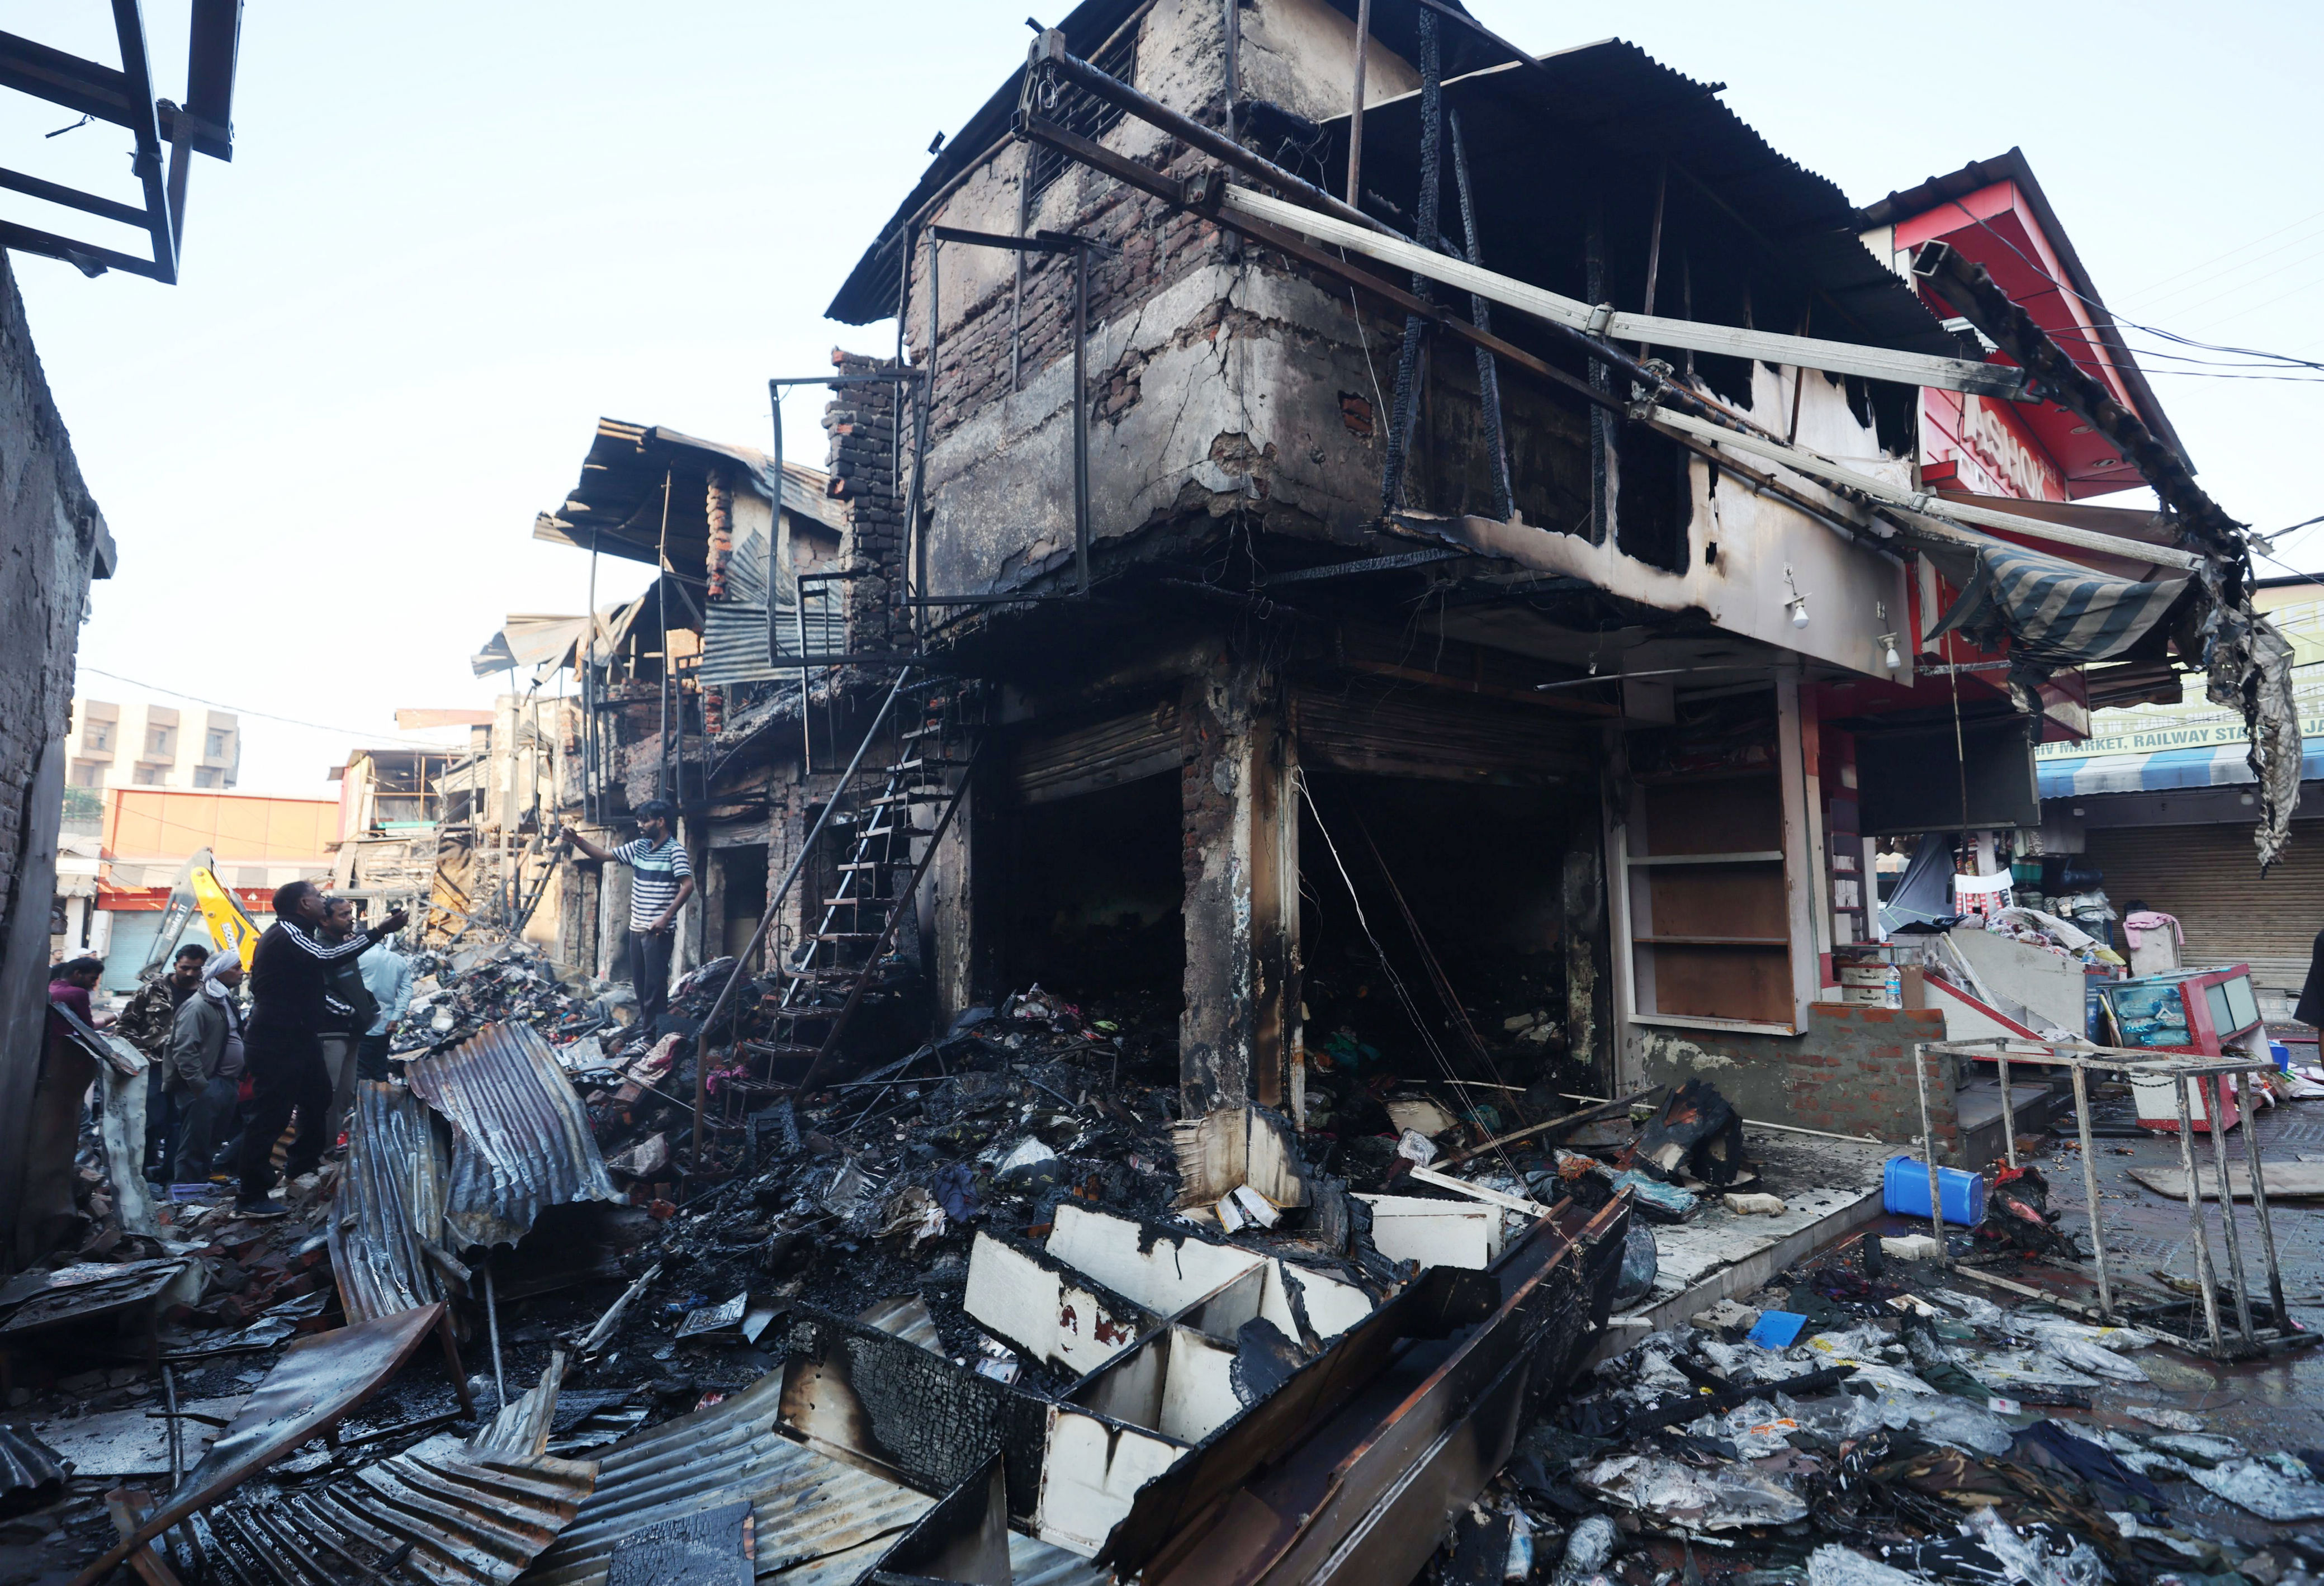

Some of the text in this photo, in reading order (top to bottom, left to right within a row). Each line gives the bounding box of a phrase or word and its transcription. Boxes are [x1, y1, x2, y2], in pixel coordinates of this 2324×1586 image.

[1963, 393, 2046, 501] ASHOK
[2060, 737, 2128, 754] MARKET,
[2134, 729, 2209, 747] RAILWAY
